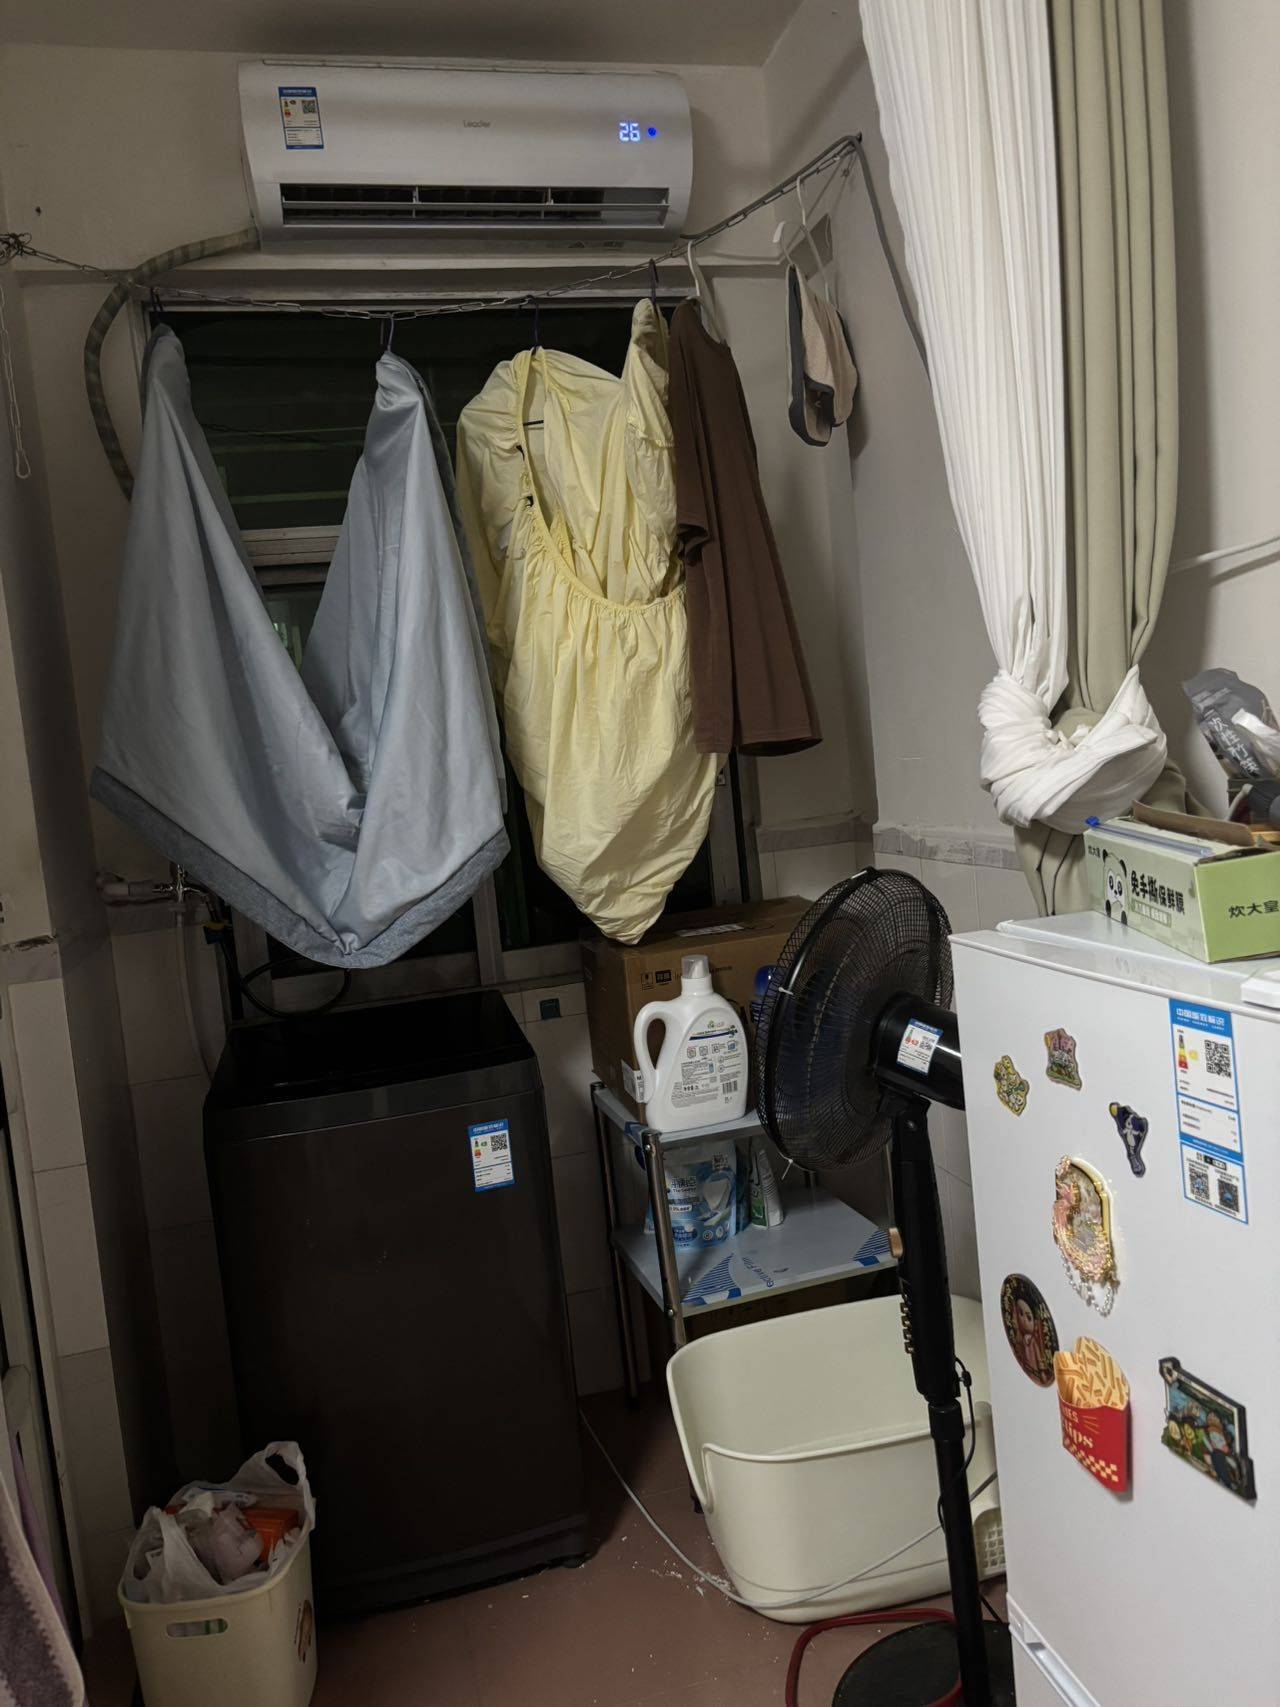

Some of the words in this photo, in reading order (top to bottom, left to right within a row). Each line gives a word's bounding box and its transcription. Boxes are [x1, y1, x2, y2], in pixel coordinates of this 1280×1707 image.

[462, 119, 491, 129] Leader
[619, 122, 641, 141] 26
[1130, 869, 1186, 916] 免手撕保鲜膜
[1228, 900, 1280, 919] 炊大皇
